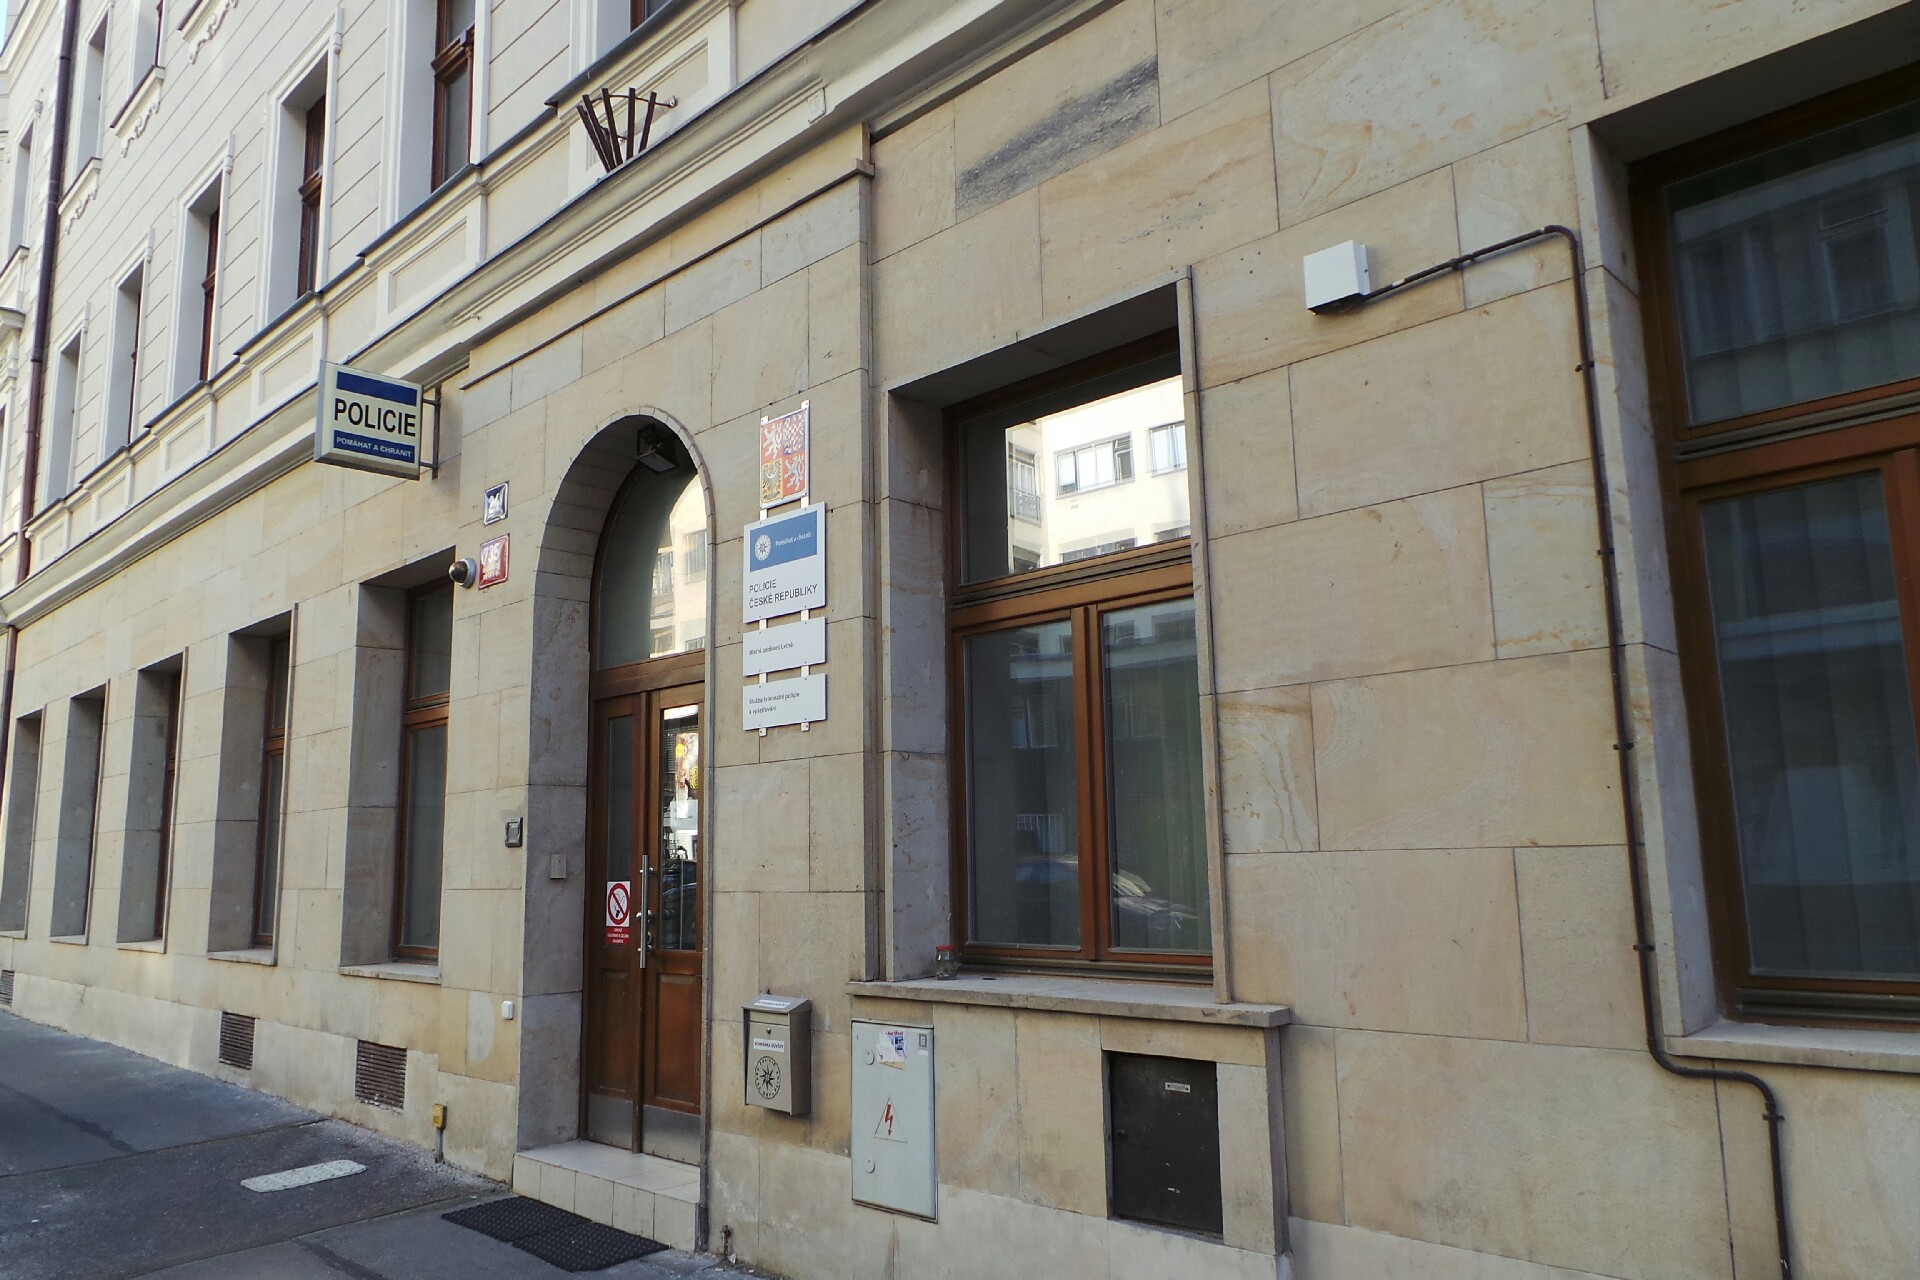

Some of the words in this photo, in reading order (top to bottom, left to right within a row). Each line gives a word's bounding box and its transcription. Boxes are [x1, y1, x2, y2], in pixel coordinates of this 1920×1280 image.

[334, 397, 416, 437] POLICIE
[482, 543, 500, 565] 735
[749, 579, 776, 593] POLICIE
[749, 593, 773, 608] ČESKÉ
[774, 584, 818, 602] REPUBLIKY
